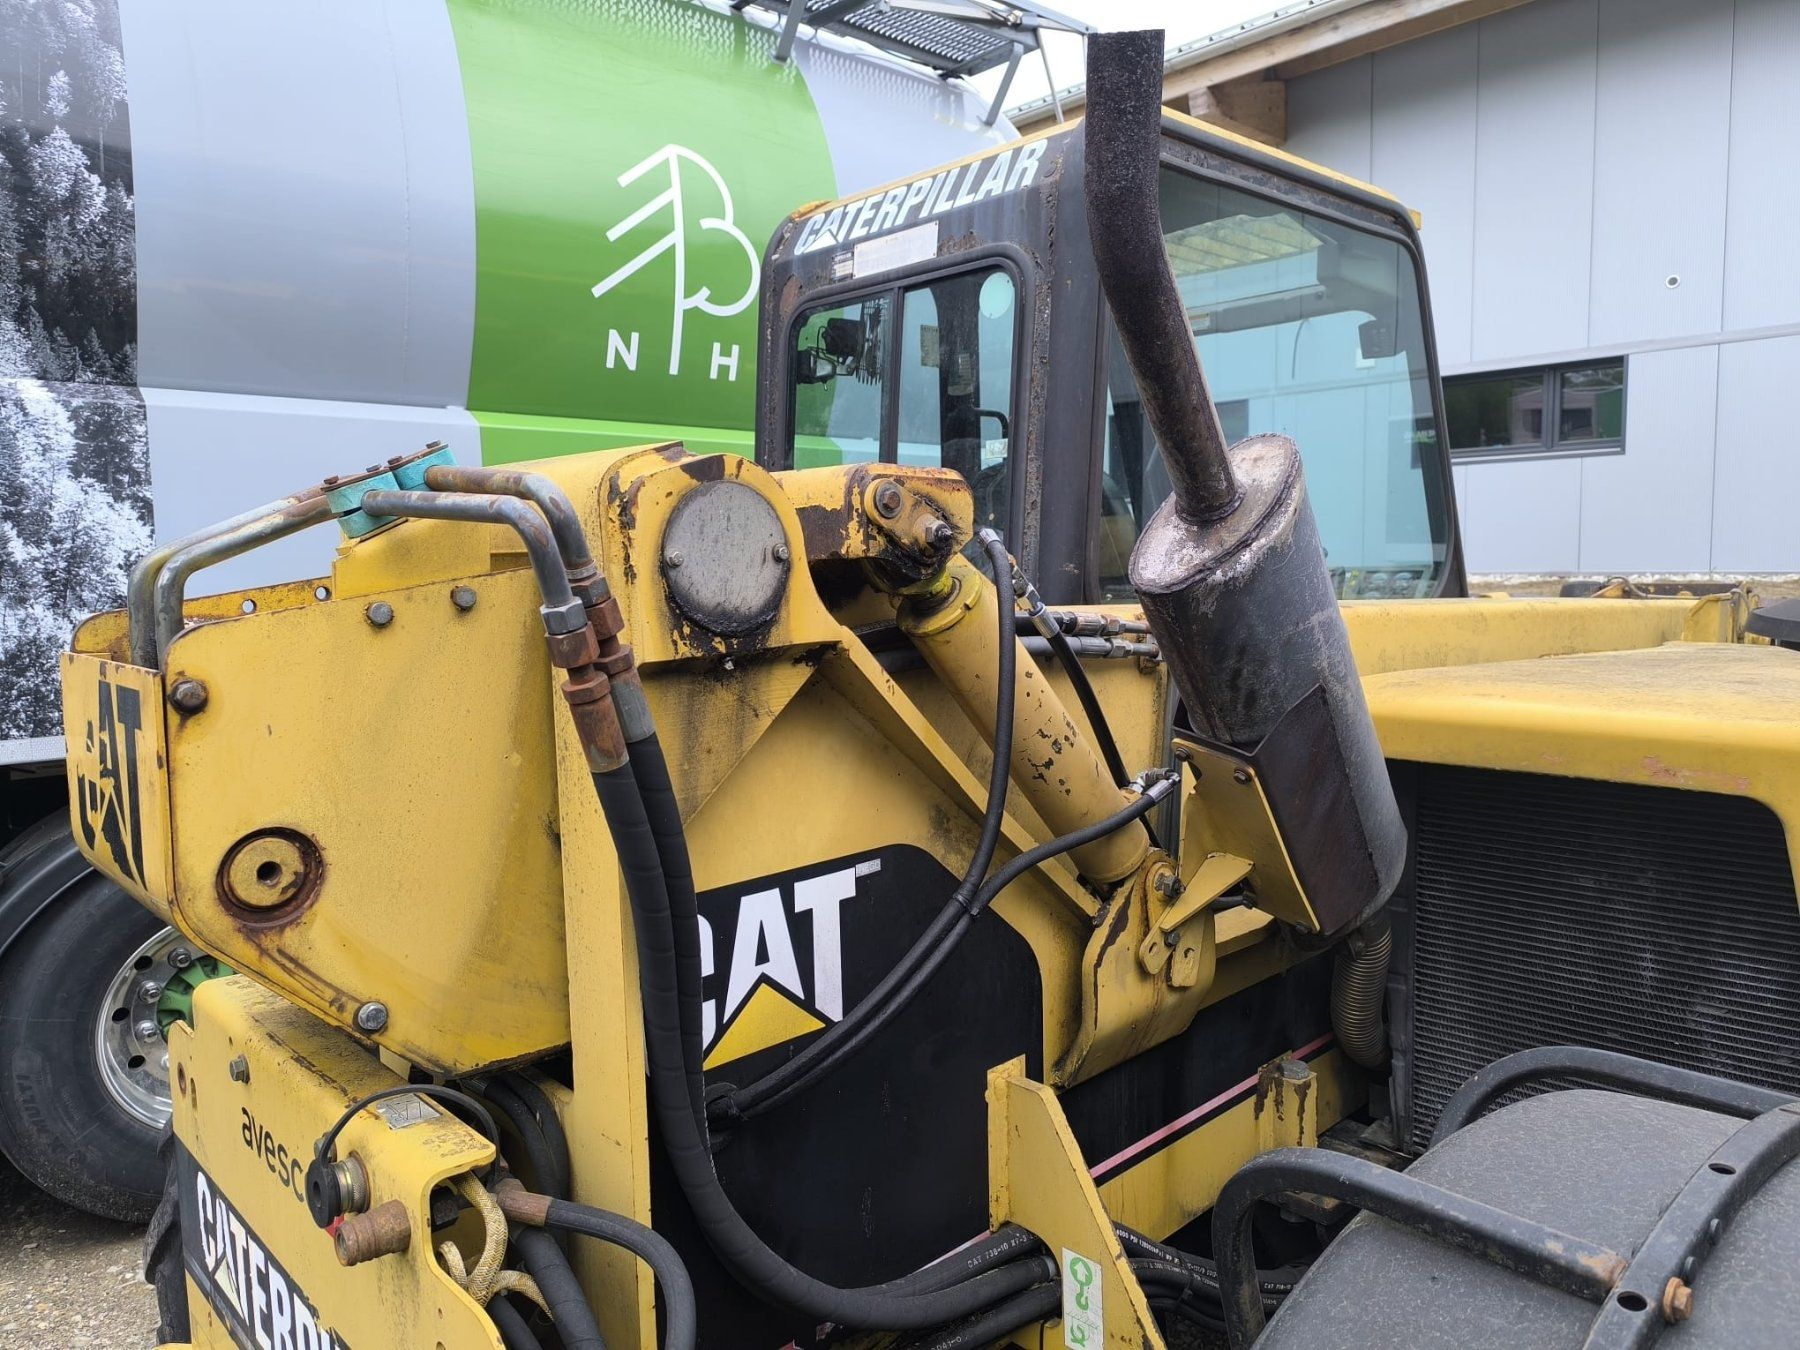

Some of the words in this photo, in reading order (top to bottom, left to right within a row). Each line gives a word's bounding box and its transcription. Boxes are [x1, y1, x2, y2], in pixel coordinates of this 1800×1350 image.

[793, 137, 1049, 257] CATERPILLAR
[606, 328, 640, 371] N
[709, 341, 740, 382] H
[241, 1106, 305, 1203] avesc
[967, 1255, 982, 1269] CAT
